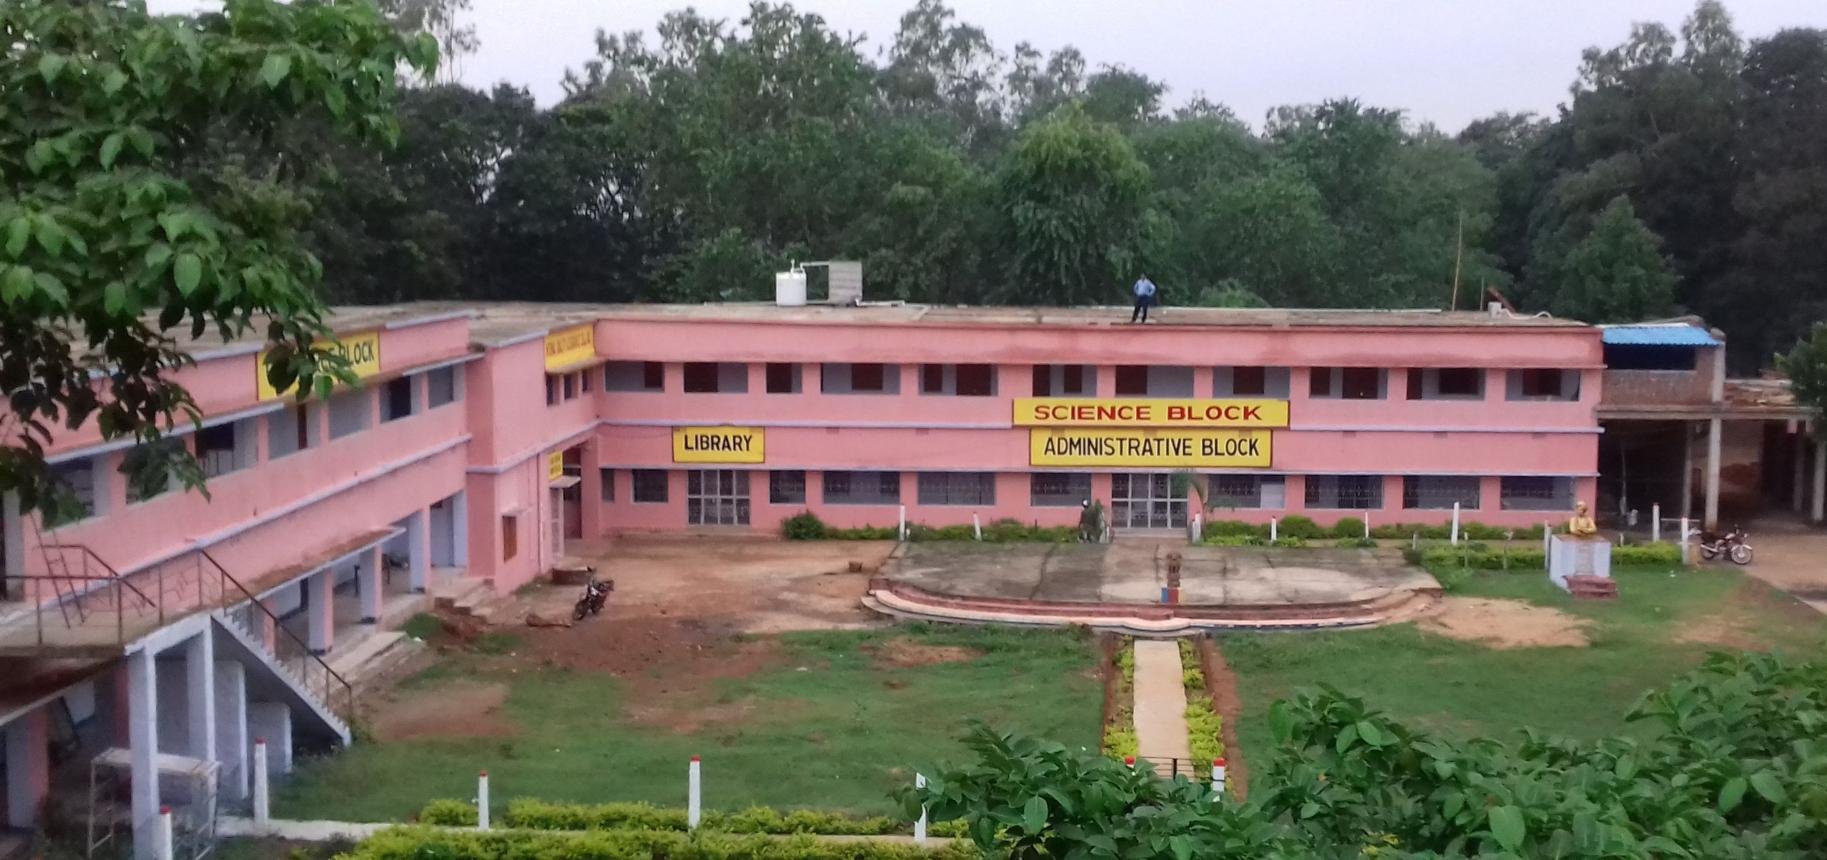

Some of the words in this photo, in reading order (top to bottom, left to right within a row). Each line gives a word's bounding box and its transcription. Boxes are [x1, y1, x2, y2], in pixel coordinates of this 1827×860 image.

[1034, 405, 1152, 421] SCIENCE
[1167, 405, 1262, 421] BLOCK
[684, 434, 752, 452] LIBRARY
[1044, 437, 1193, 456] ADMINISTRATIVE
[1201, 438, 1259, 456] BLOCK
